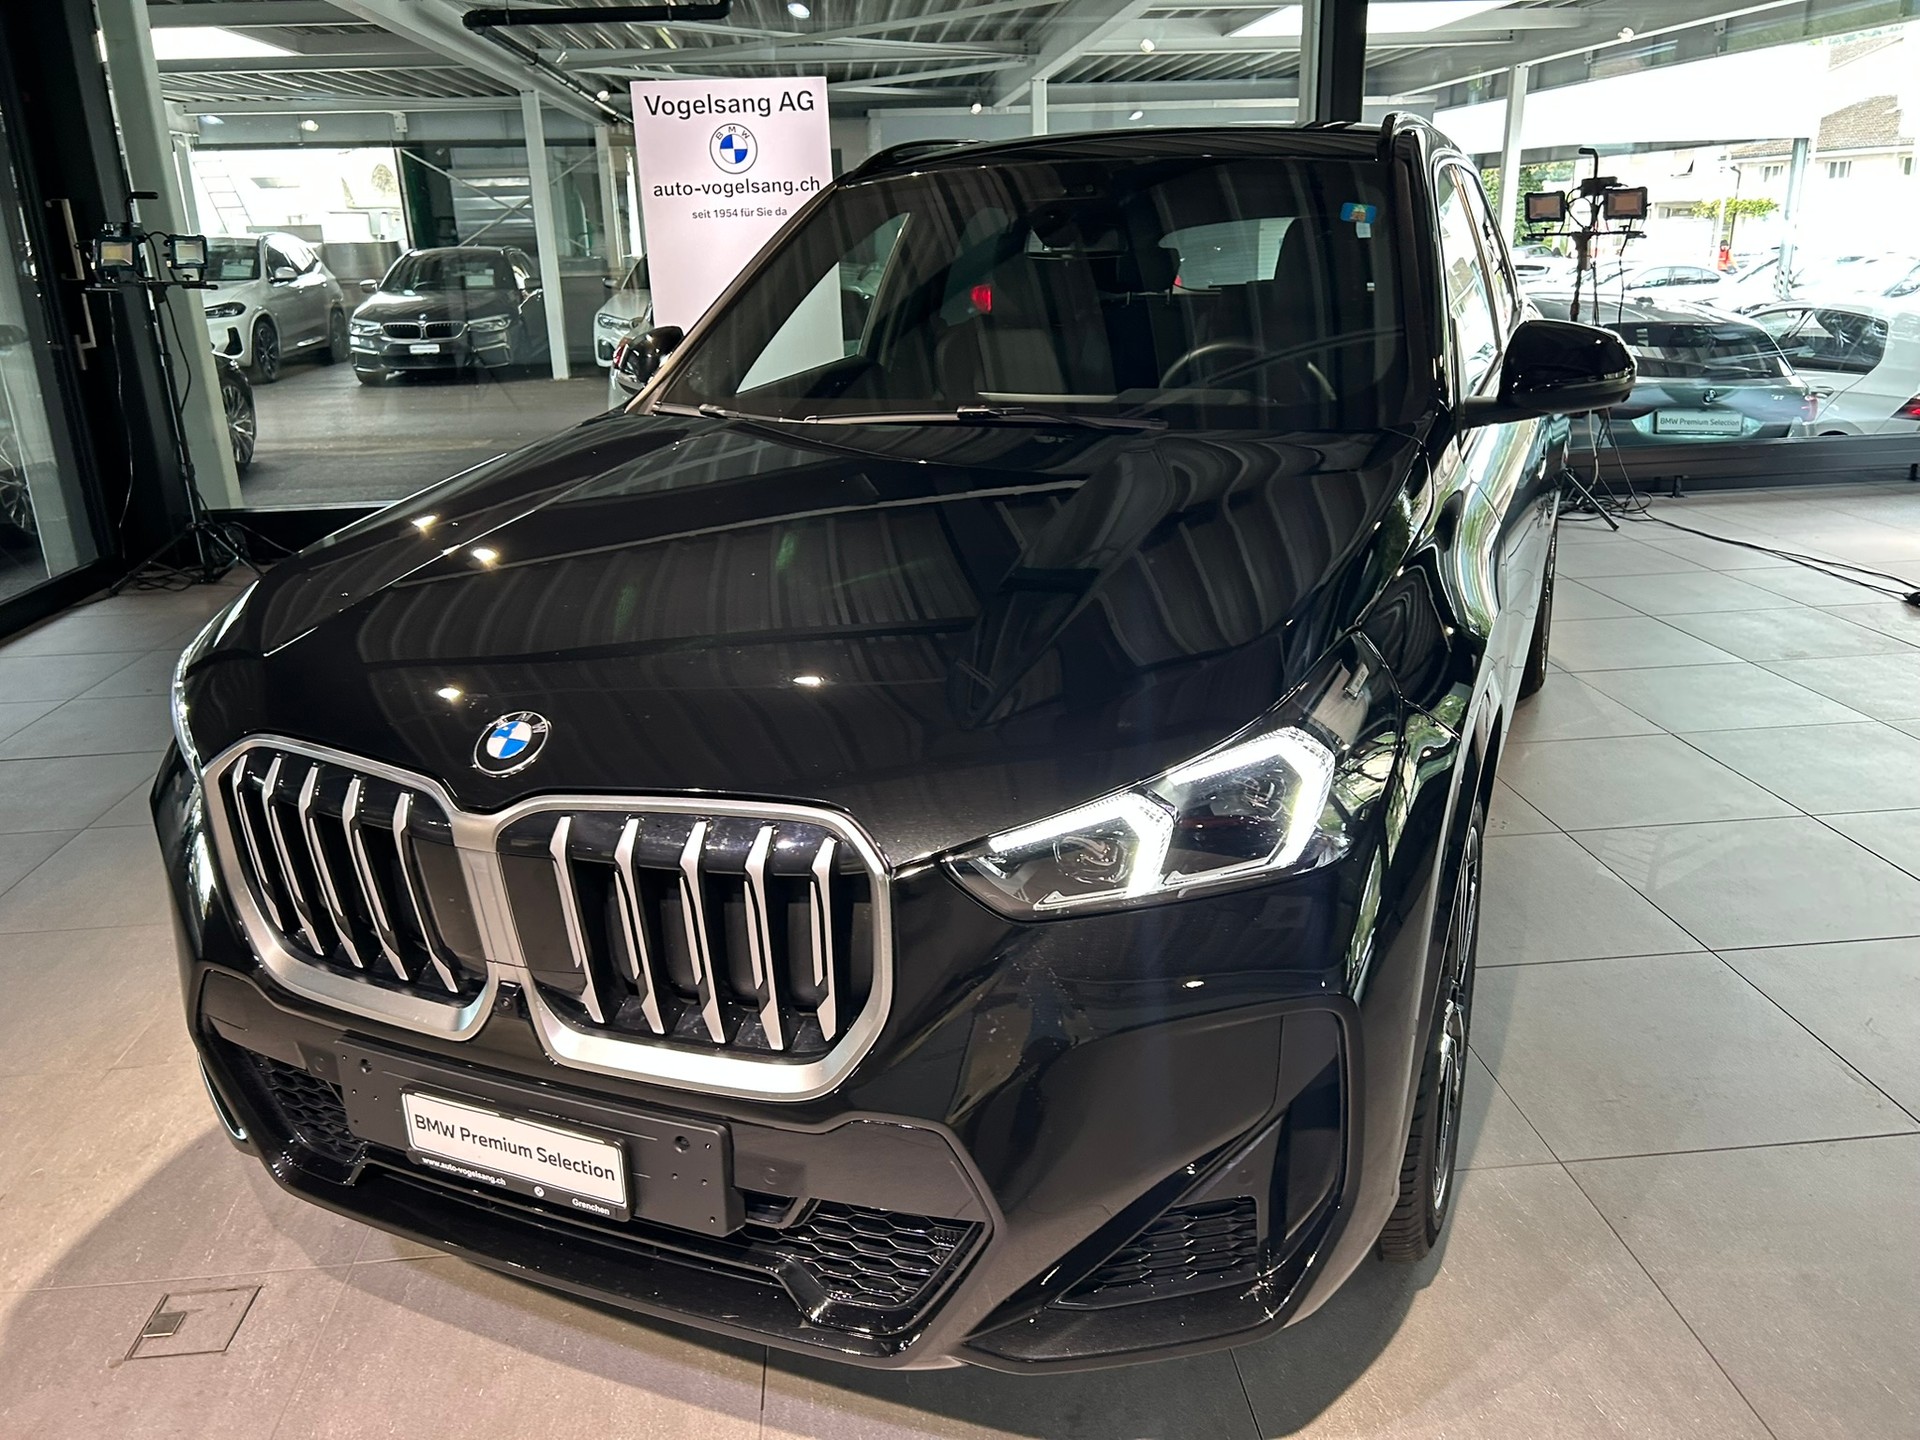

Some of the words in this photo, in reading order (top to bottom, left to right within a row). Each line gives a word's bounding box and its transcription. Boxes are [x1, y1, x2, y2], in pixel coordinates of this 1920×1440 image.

[643, 94, 771, 120] Vogelsang
[779, 90, 814, 112] AG
[715, 126, 750, 140] BMW
[653, 176, 820, 198] auto-vogelsang.ch
[692, 210, 711, 219] seit
[713, 209, 738, 218] 1954
[740, 208, 754, 217] für
[757, 207, 773, 217] Sie
[775, 207, 788, 216] da
[1680, 418, 1709, 426] Premium
[1710, 418, 1740, 427] Selection
[414, 1114, 455, 1139] BMW
[459, 1126, 533, 1159] Premium
[536, 1146, 615, 1181] Selection
[421, 1156, 507, 1186] www.auto-vogelsang.ch
[571, 1197, 610, 1216] Grenchen
